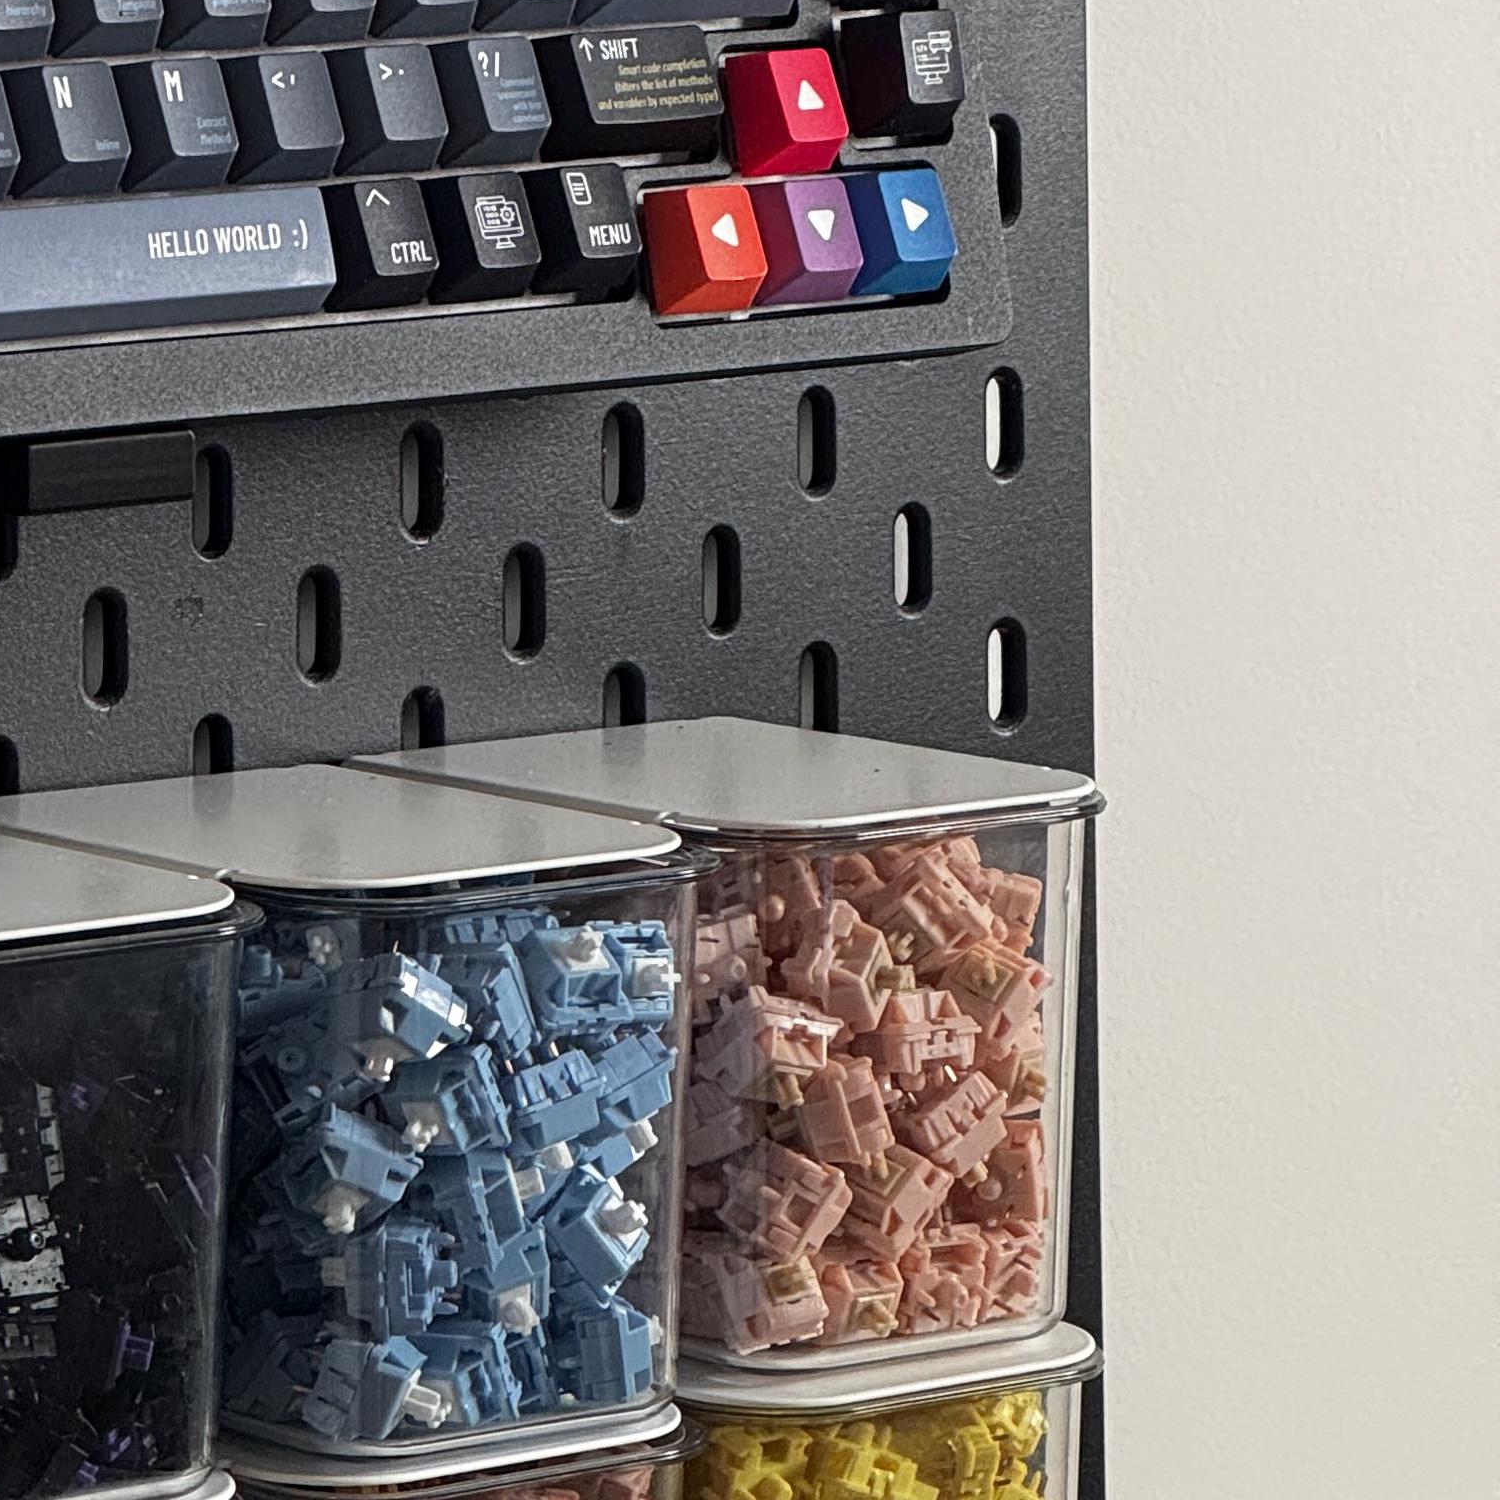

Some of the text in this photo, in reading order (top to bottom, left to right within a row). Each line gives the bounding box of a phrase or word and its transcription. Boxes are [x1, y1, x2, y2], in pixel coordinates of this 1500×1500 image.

[600, 38, 638, 59] SHIFT
[618, 58, 707, 76] Smart code completion
[53, 76, 72, 108] N
[164, 71, 183, 101] M
[641, 79, 654, 90] the
[148, 229, 208, 258] HELLO
[213, 224, 281, 253] WORLD
[589, 224, 631, 246] MENU
[391, 241, 431, 263] CTRL
